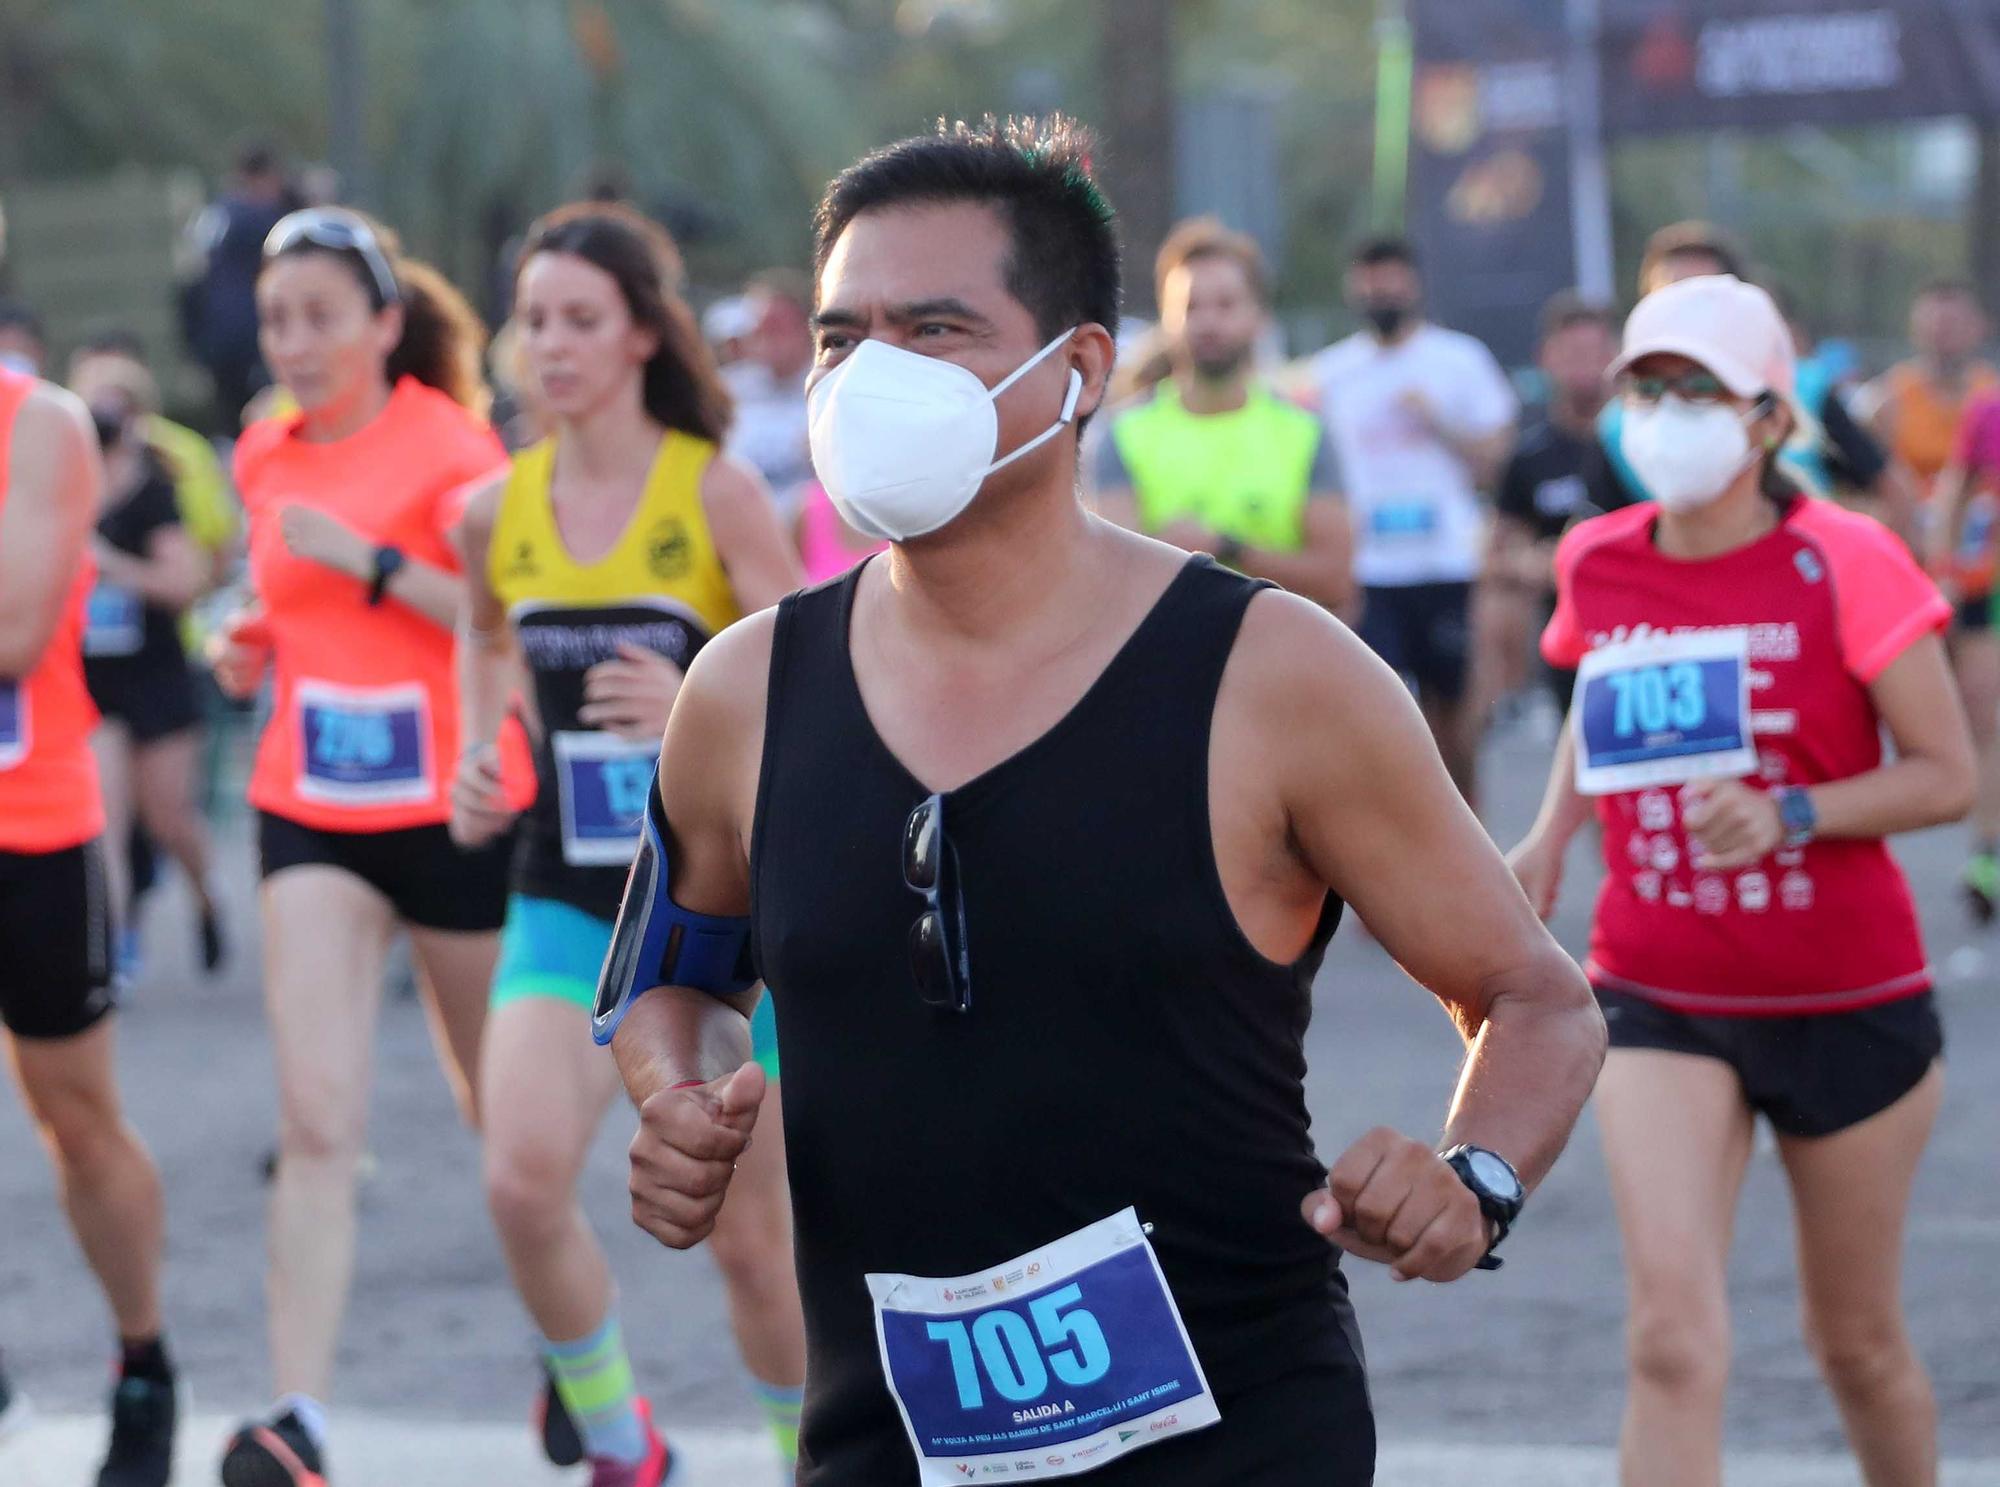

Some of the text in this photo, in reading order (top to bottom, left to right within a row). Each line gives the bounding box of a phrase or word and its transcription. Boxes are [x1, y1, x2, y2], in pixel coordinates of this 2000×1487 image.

[1608, 662, 1706, 737] 703
[926, 1283, 1111, 1409] 705
[975, 1433, 991, 1443] PEU
[1040, 1423, 1052, 1433] DE
[1052, 1418, 1076, 1430] SANT
[1126, 1390, 1150, 1407] SANT
[1150, 1379, 1181, 1397] ISIDRE
[1013, 1399, 1076, 1423] SALIDA A
